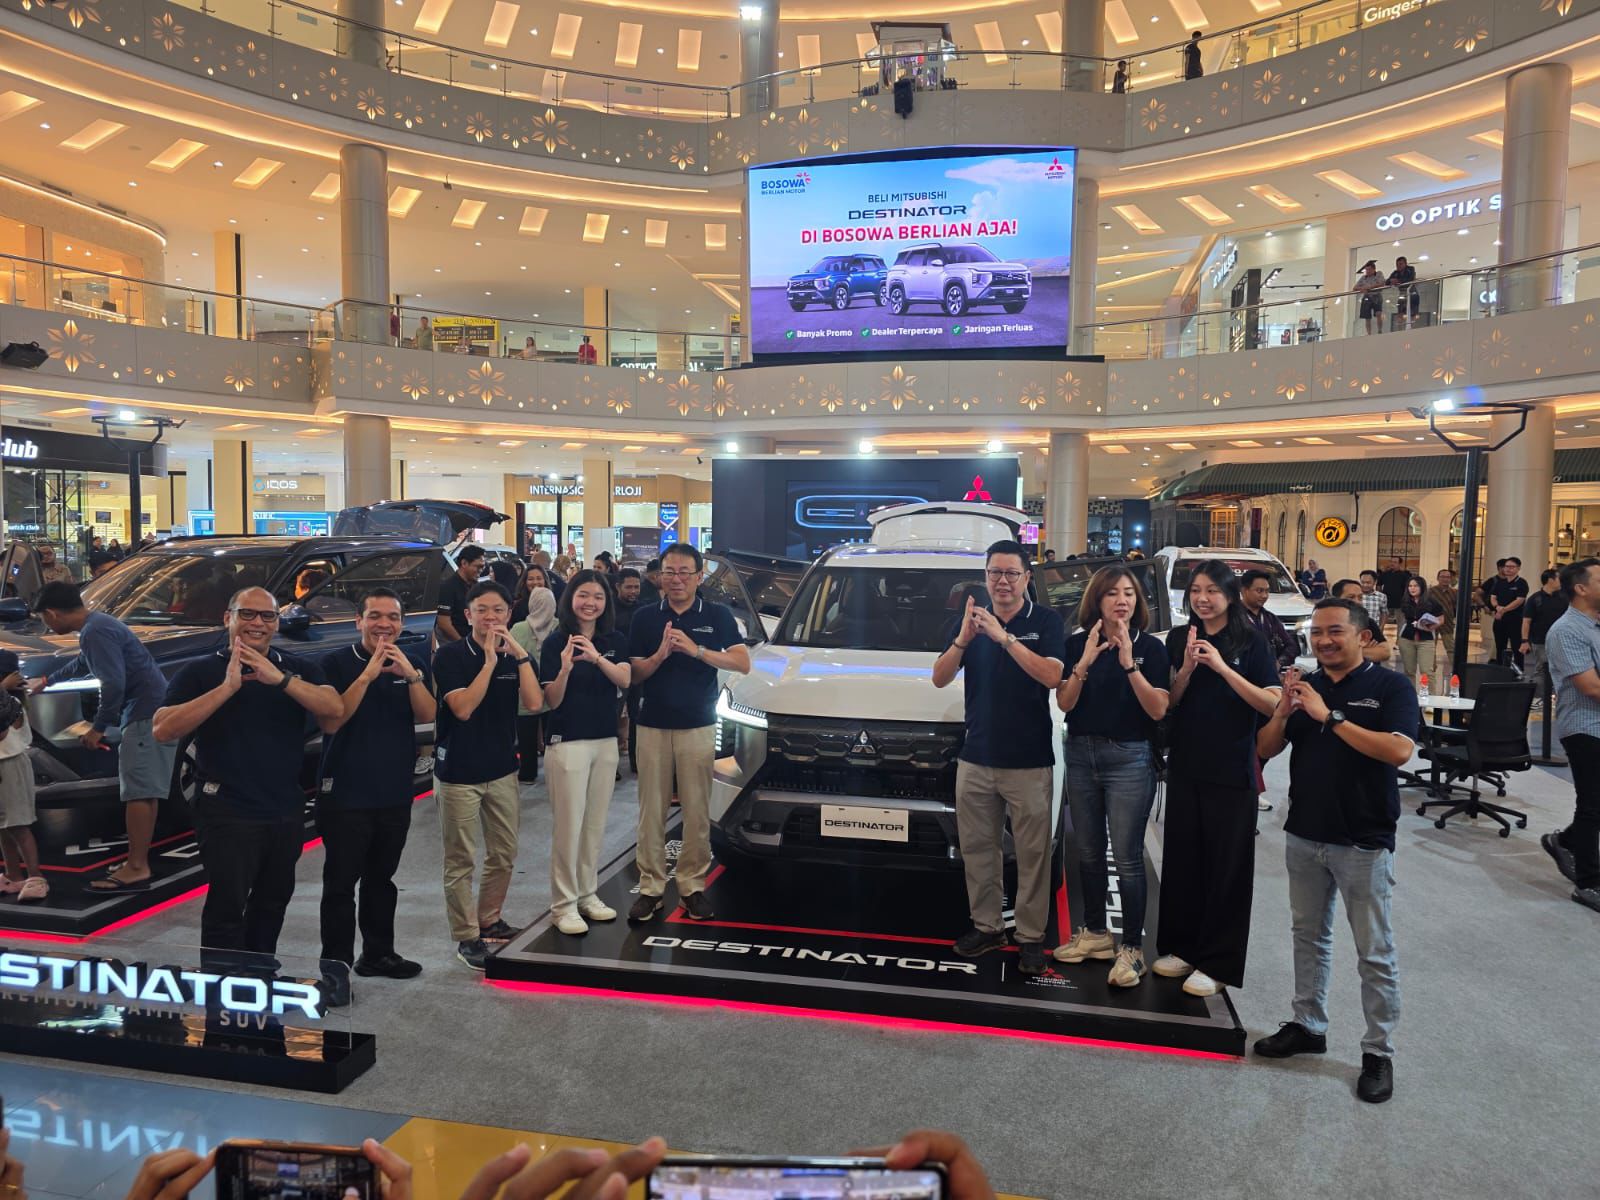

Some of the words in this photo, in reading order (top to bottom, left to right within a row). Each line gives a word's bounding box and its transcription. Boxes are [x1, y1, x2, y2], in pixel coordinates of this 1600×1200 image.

[761, 178, 805, 189] BOSOWA
[868, 194, 889, 203] BELI
[891, 191, 947, 202] MITSUBISHI
[848, 205, 967, 220] DESTINATOR
[1411, 198, 1481, 225] OPTIK
[801, 230, 817, 244] DI
[822, 227, 894, 243] BOSOWA
[899, 223, 972, 240] BERLIAN
[977, 220, 1018, 236] AJA!
[796, 329, 825, 338] Banyak
[826, 328, 853, 337] Promo
[872, 327, 897, 336] Dealer
[898, 326, 943, 337] Terpercaya
[964, 325, 1001, 335] Jaringan
[1002, 323, 1033, 332] Terluas
[266, 480, 298, 489] IQOS
[529, 484, 584, 496] INTERNASIO
[613, 485, 642, 496] RLOJI
[824, 819, 904, 832] DESTINATOR
[641, 936, 978, 974] DESTINATOR
[219, 1009, 267, 1031] SUV
